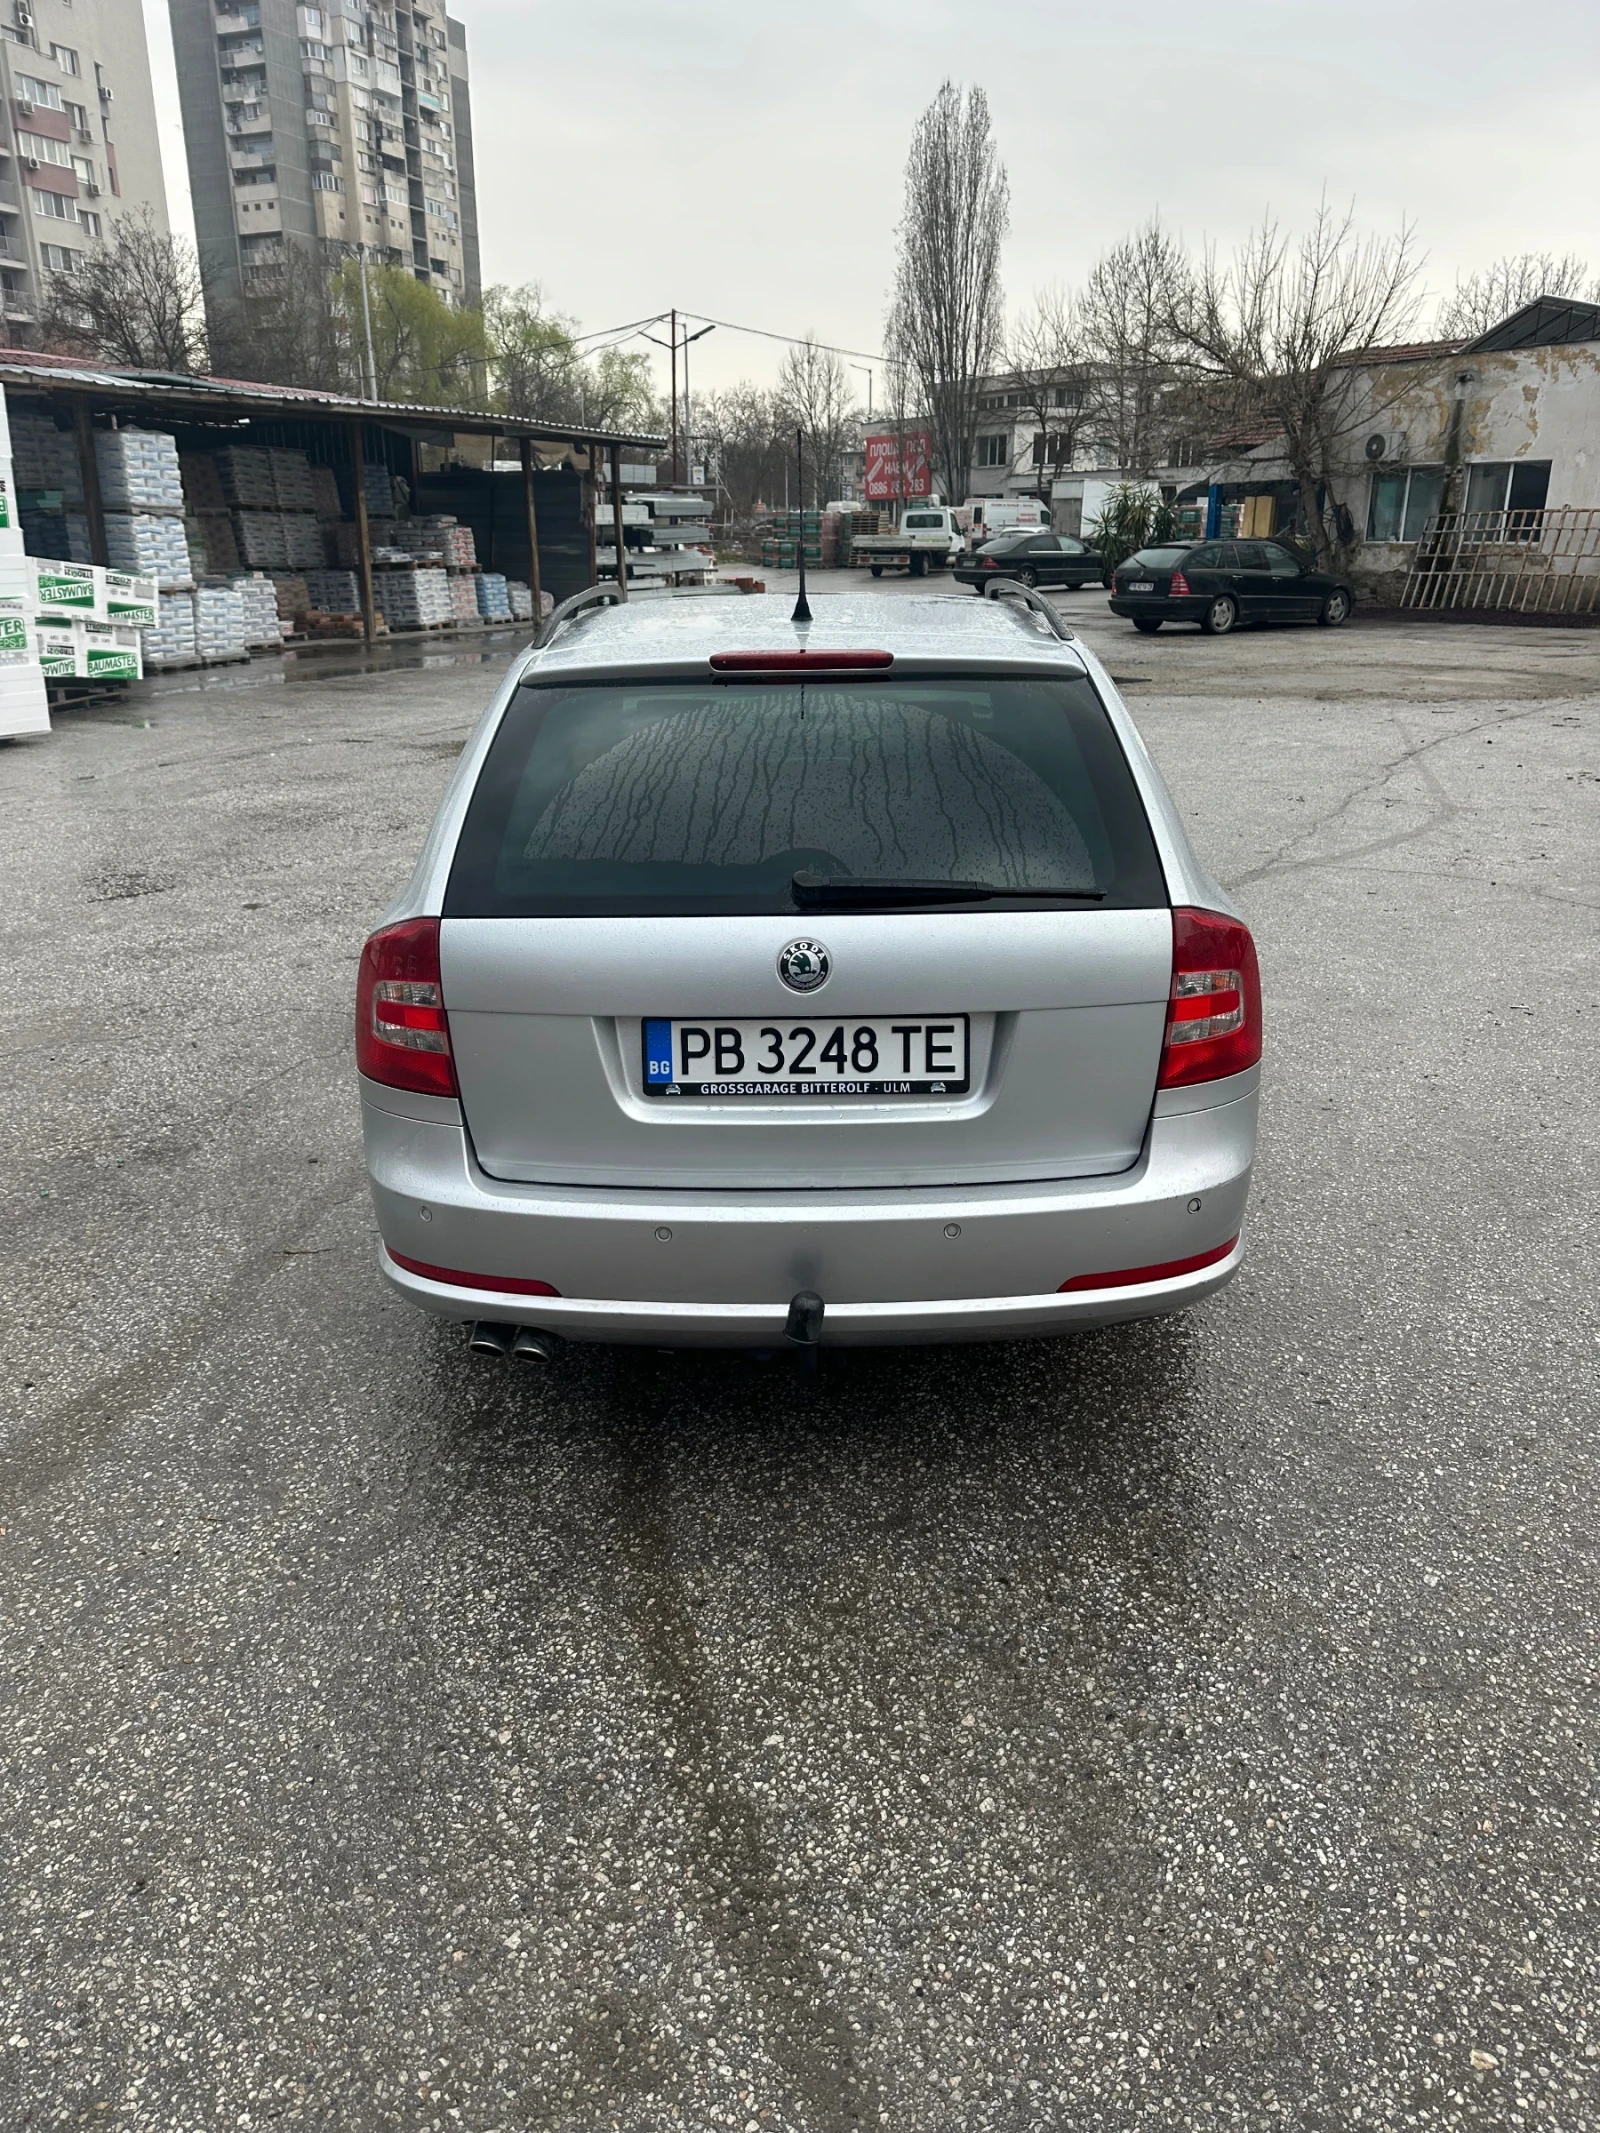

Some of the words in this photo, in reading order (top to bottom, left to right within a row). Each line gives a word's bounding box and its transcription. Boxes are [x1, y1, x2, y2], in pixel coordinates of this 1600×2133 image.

[869, 481, 888, 495] 0886
[909, 478, 924, 492] 283
[39, 583, 94, 601] BAUMASTER
[88, 656, 137, 673] BAUMASTER
[680, 1027, 745, 1075] PB
[757, 1026, 879, 1075] 3248
[891, 1025, 956, 1073] TE
[649, 1060, 670, 1075] BG
[700, 1082, 797, 1095] GROSSGARAGE
[801, 1082, 870, 1094] BITTEROLF
[883, 1082, 911, 1093] ULM
